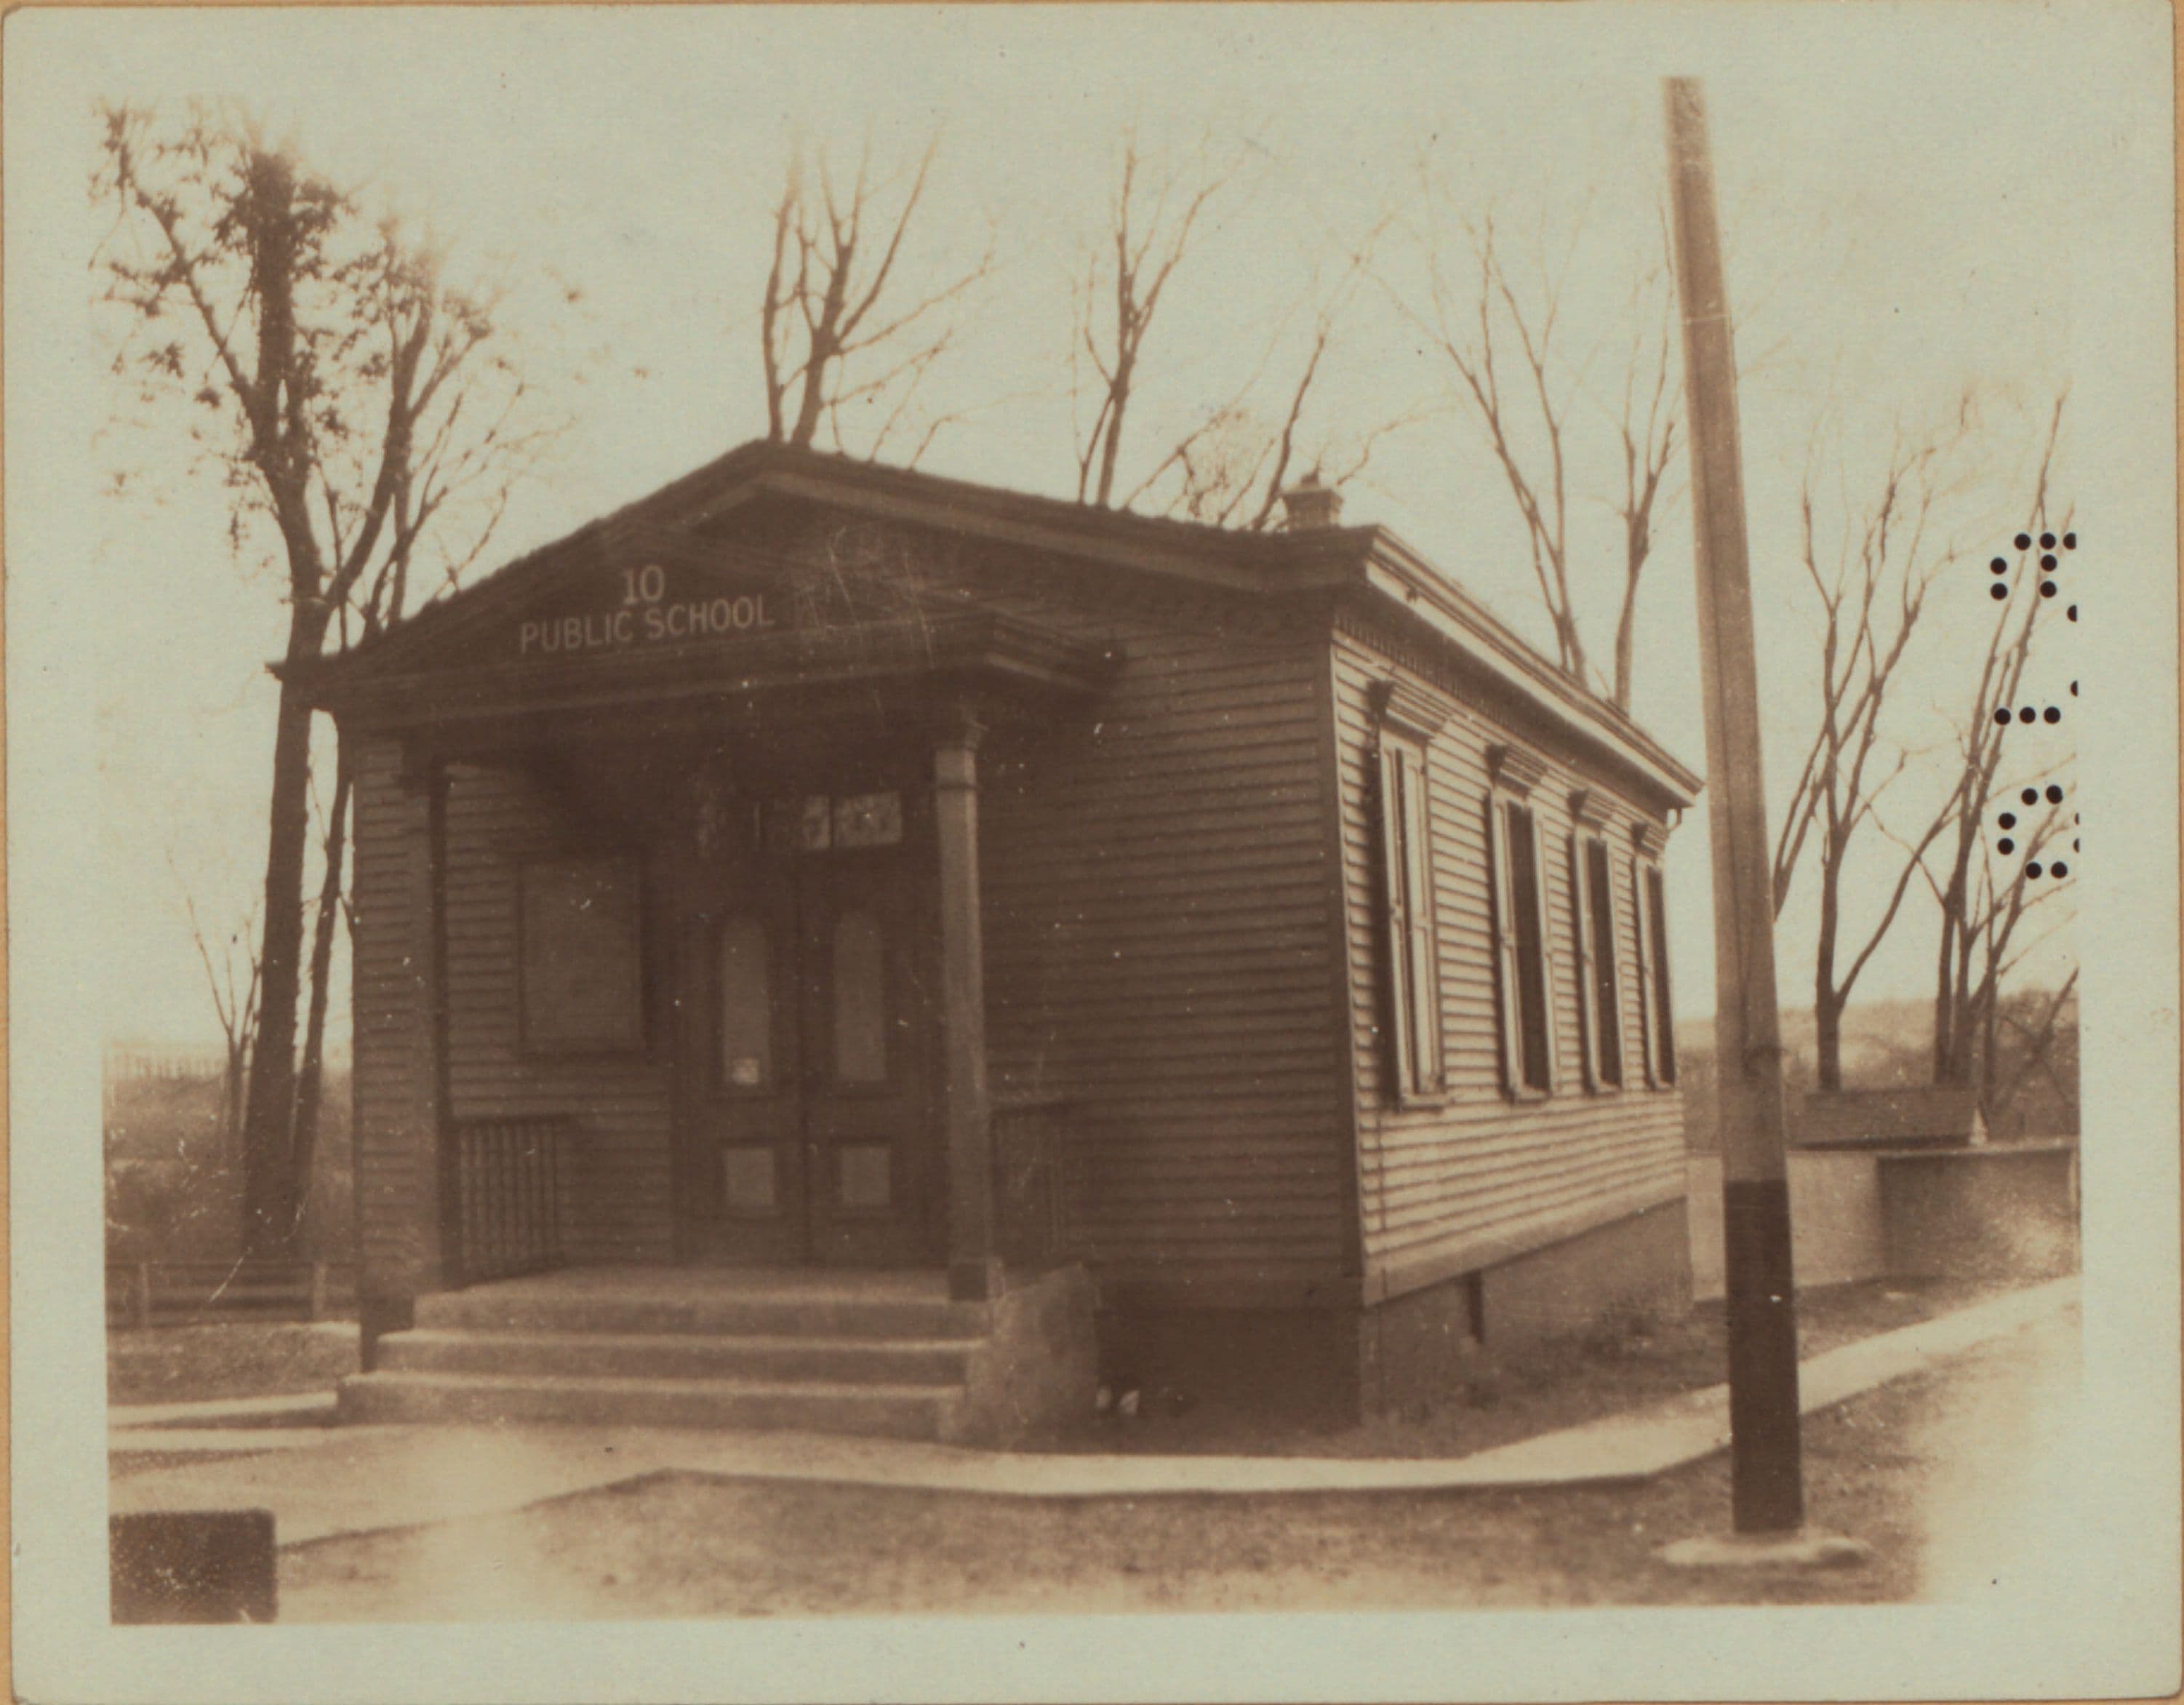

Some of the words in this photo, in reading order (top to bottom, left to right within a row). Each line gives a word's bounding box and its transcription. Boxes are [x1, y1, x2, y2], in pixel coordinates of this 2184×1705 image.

[622, 564, 665, 605] 10
[519, 610, 634, 654] PUBLIC
[644, 594, 776, 639] SCHOOL
